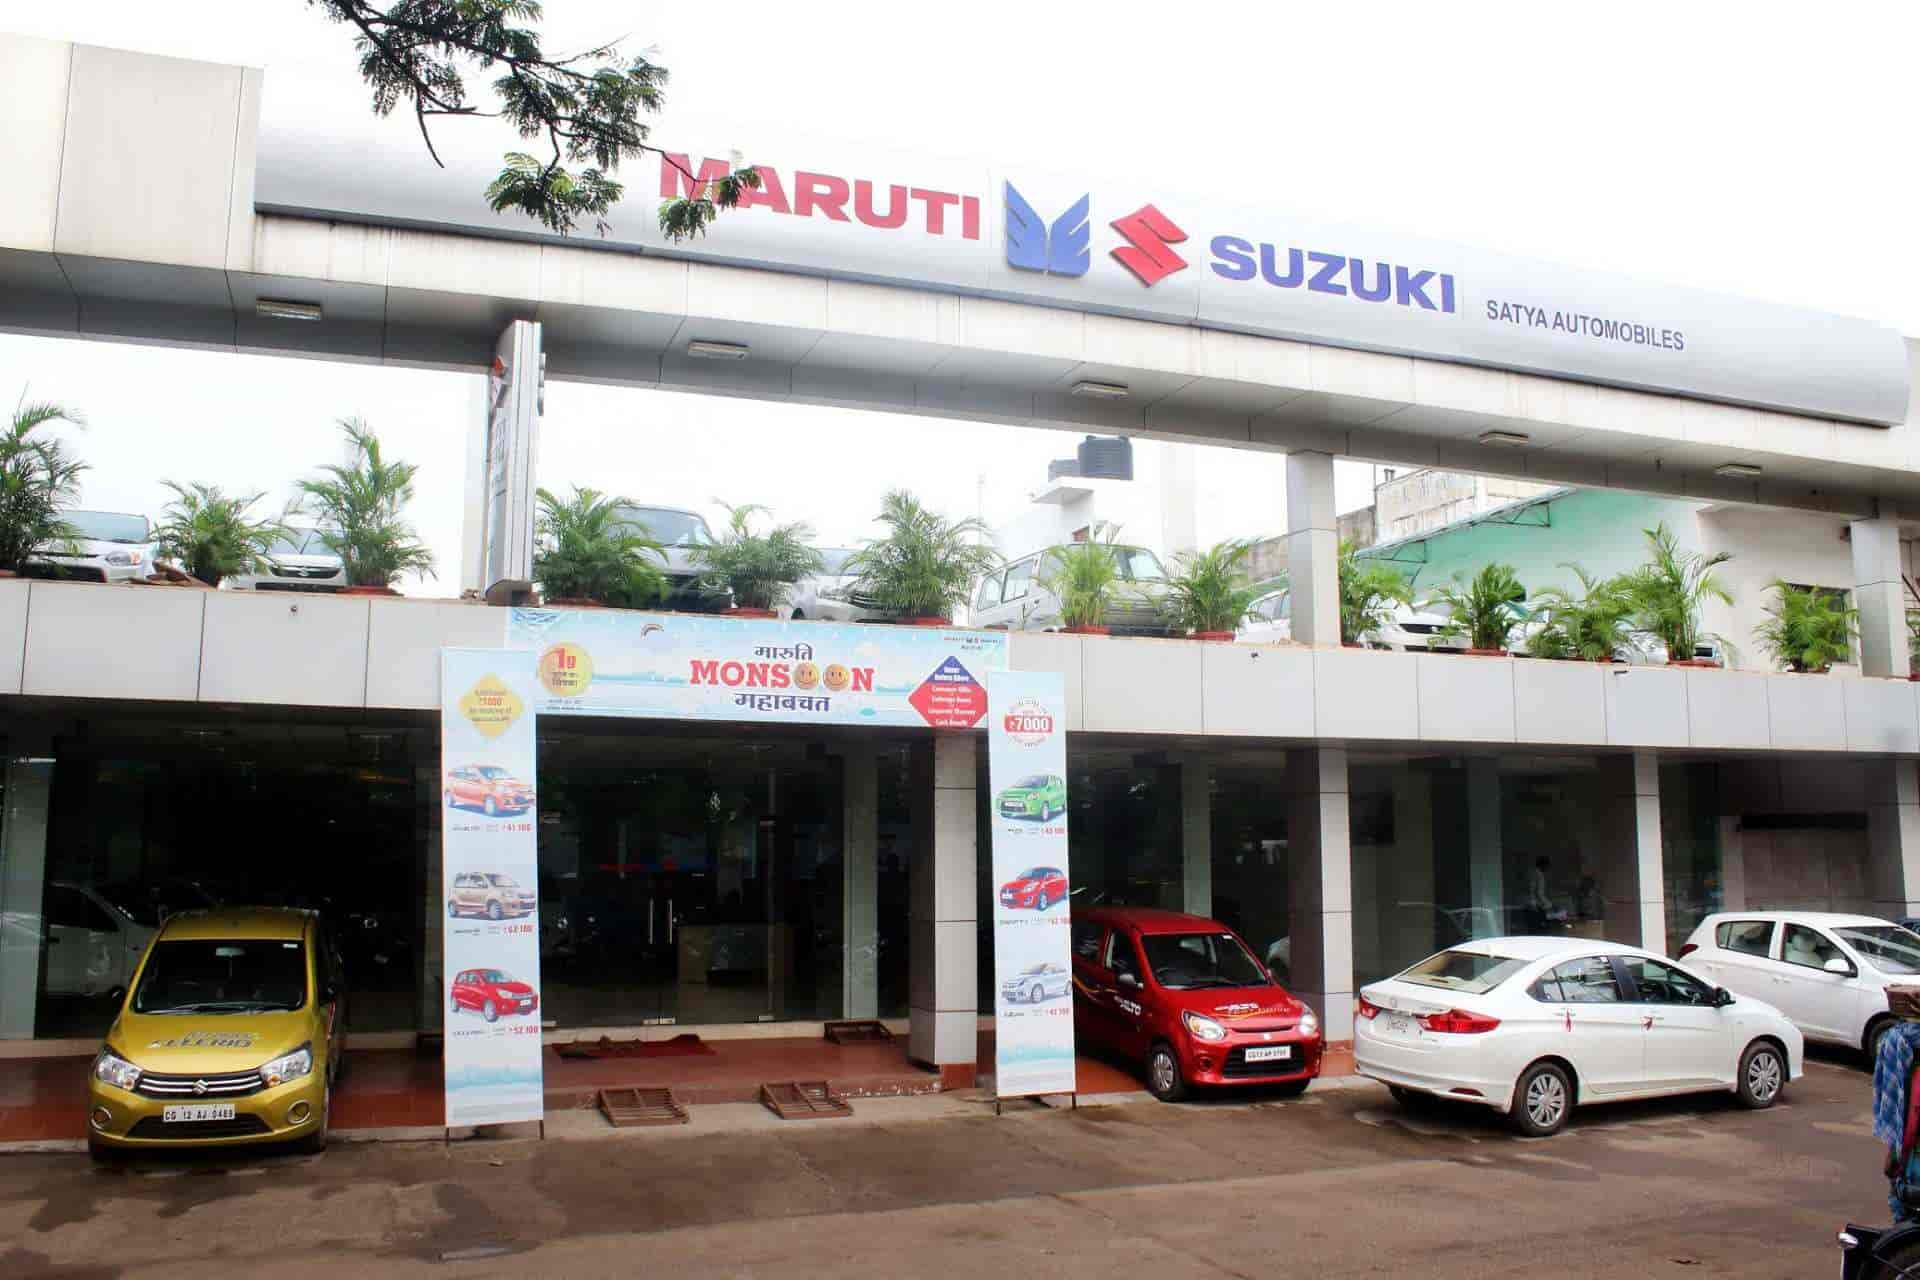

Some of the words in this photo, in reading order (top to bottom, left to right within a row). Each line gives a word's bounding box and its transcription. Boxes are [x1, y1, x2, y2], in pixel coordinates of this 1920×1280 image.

[660, 151, 980, 240] MARUTI
[1209, 235, 1456, 314] SUZUKI
[1487, 299, 1548, 329] SATYA
[1552, 311, 1685, 351] AUTOMOBILES
[754, 643, 814, 661] मारुति
[734, 693, 832, 712] महाबचत
